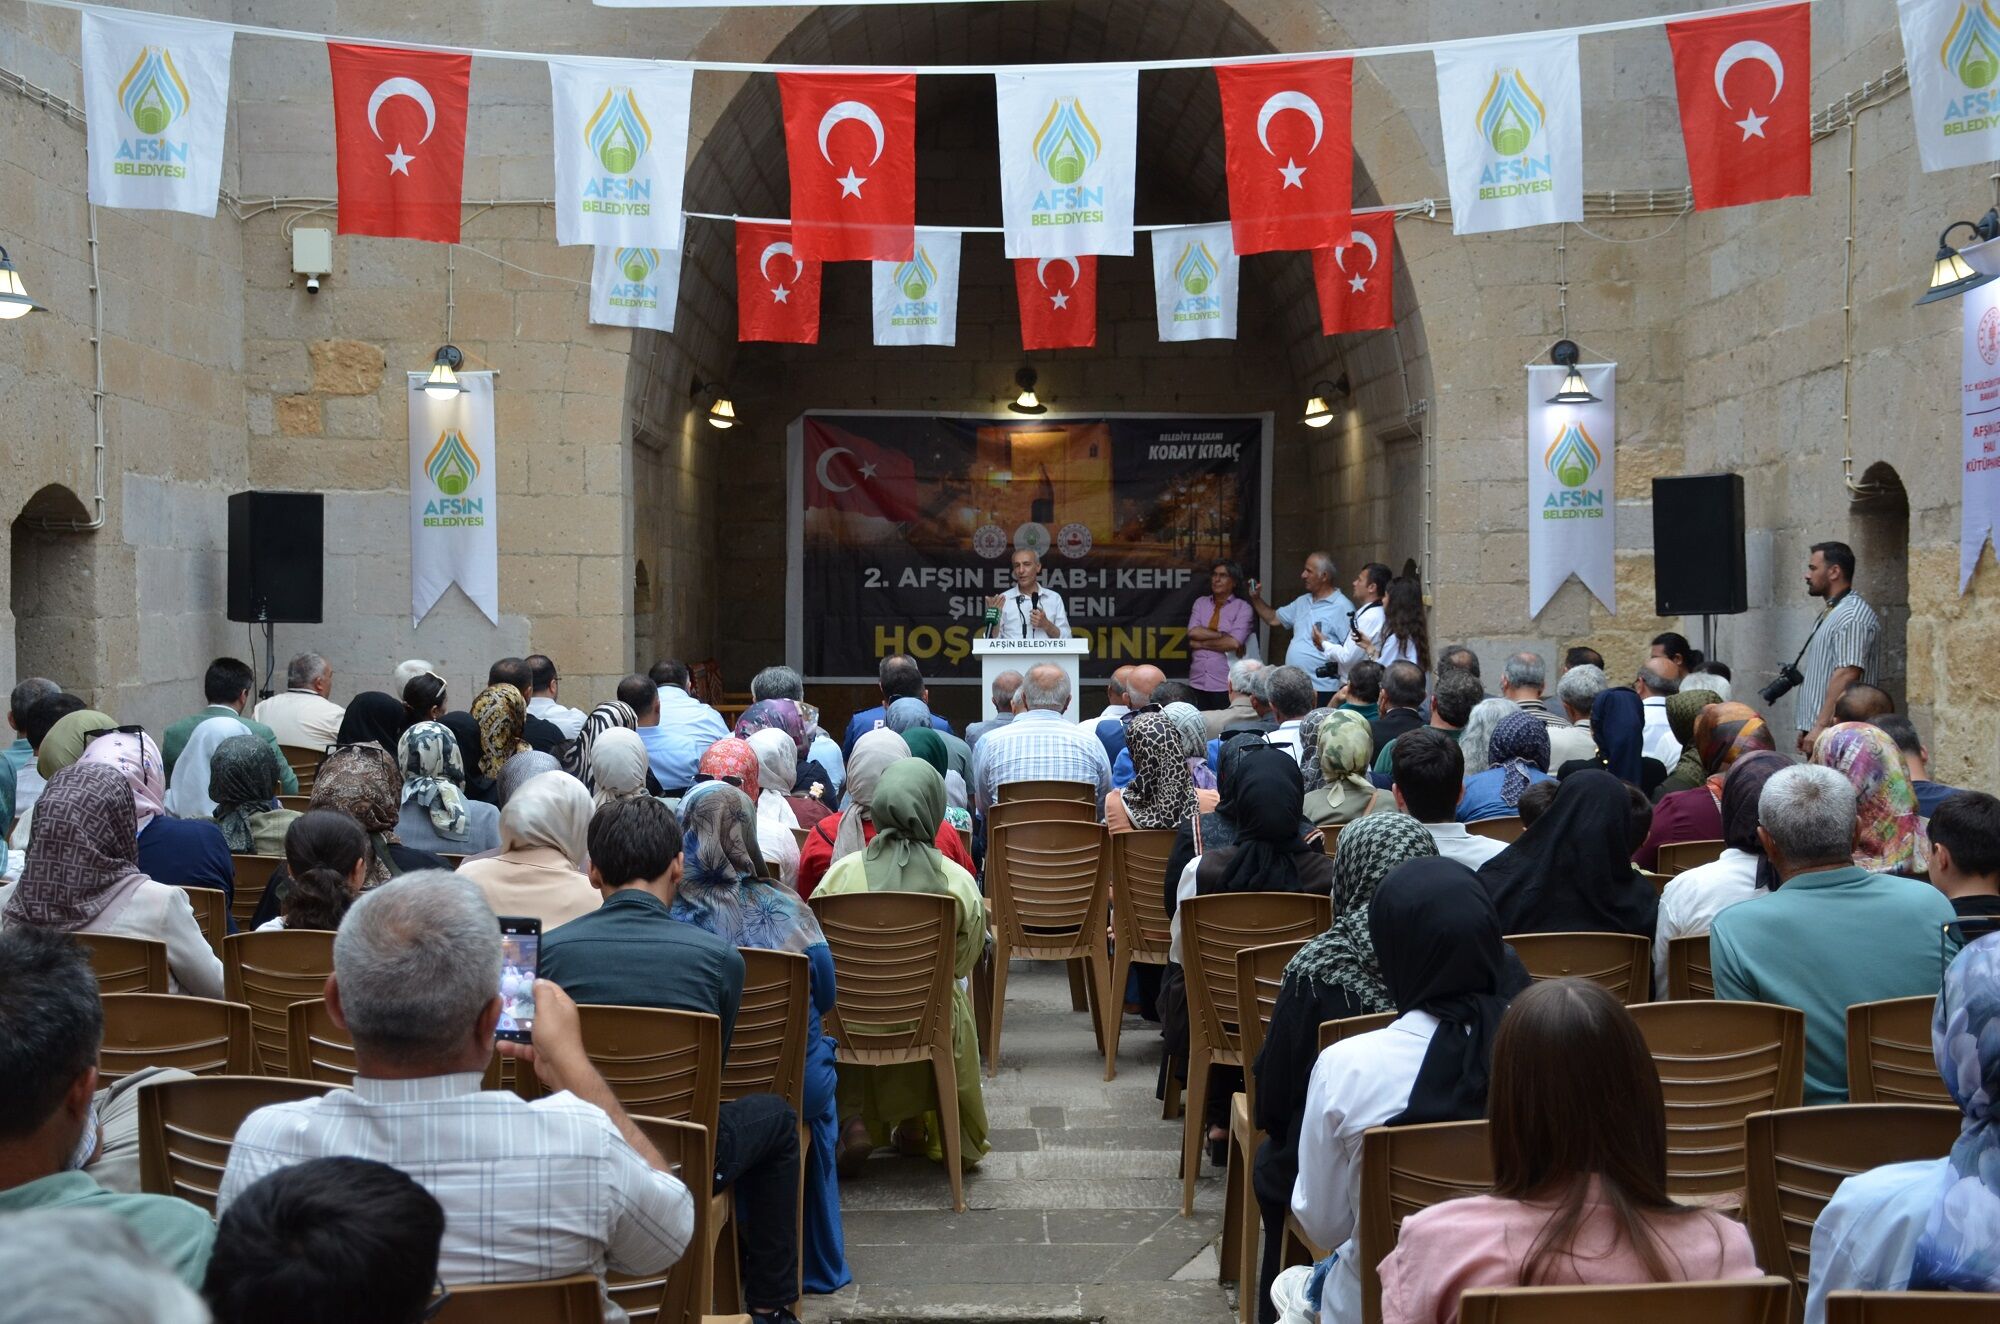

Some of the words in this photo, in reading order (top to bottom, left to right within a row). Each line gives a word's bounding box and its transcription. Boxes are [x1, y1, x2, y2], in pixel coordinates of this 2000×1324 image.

[1148, 444, 1197, 460] KORAY
[1198, 443, 1242, 462] KIRAÇ
[864, 567, 889, 588] 2.
[898, 567, 984, 592] AFŞİN
[1116, 568, 1191, 589] KEHF
[949, 596, 983, 620] Şİİ
[1017, 640, 1066, 648] BELEDİYESİ
